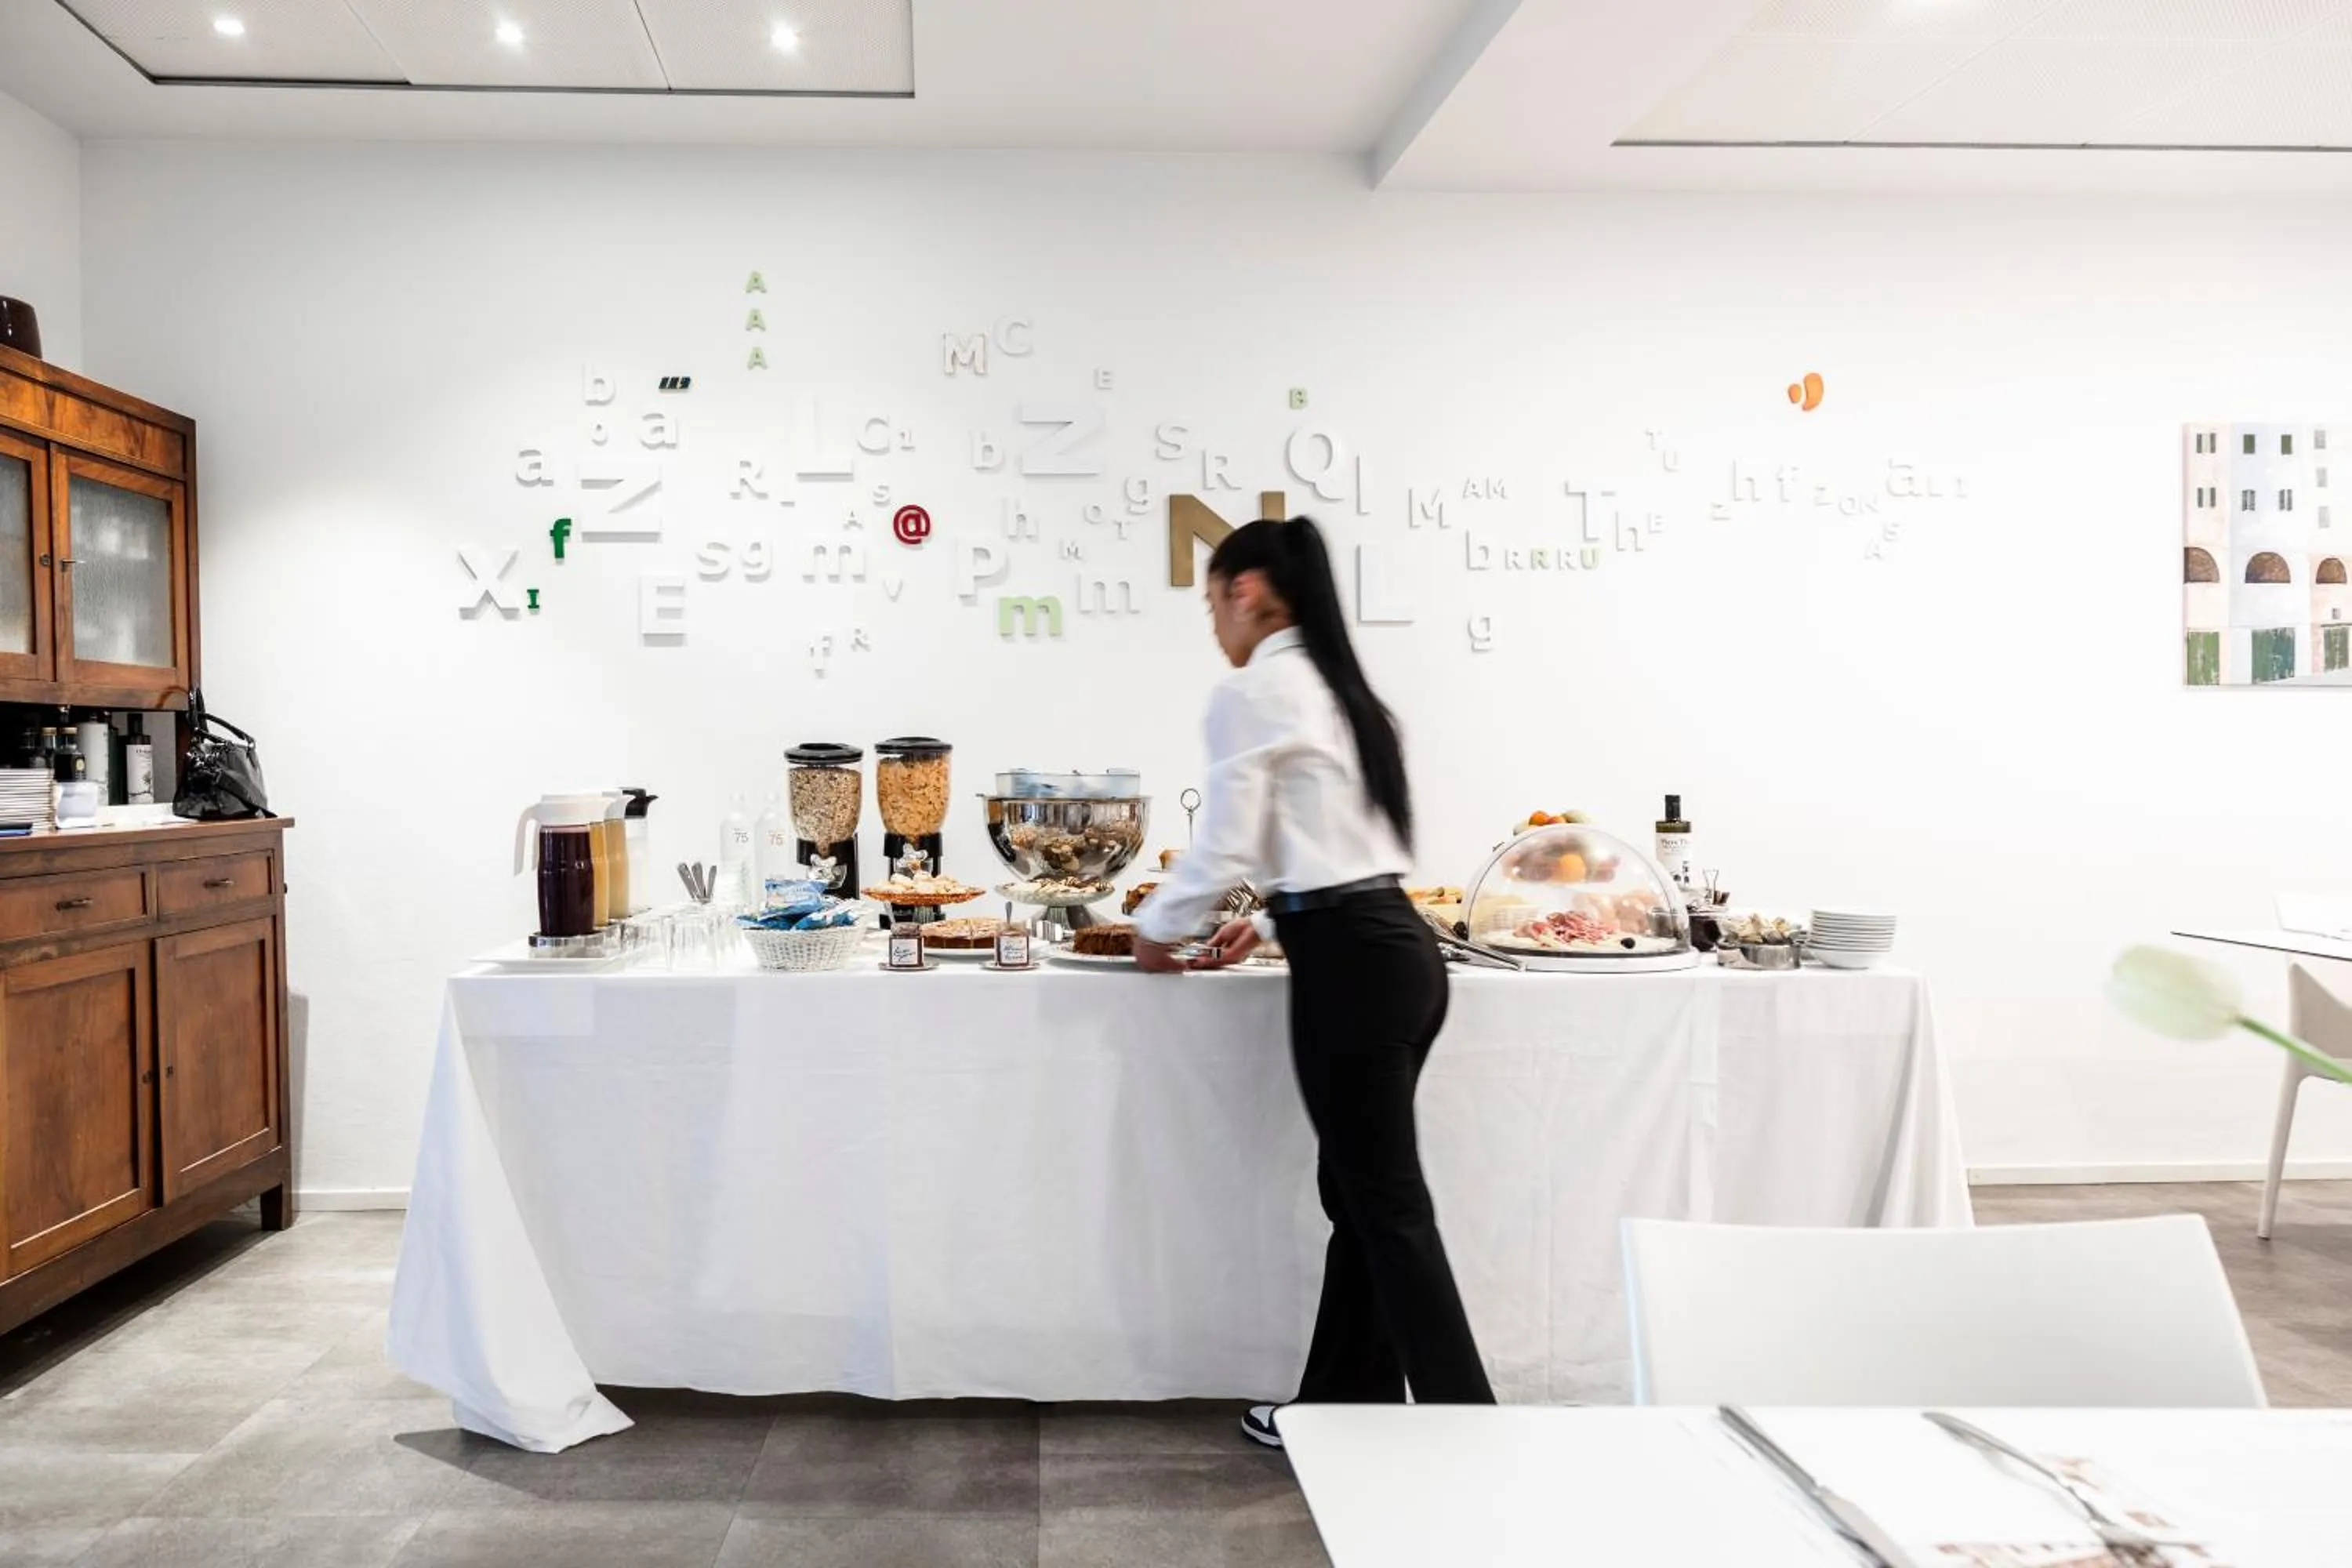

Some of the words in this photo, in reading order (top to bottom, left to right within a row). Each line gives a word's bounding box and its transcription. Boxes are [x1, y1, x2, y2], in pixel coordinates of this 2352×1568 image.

[746, 270, 768, 293] A
[745, 307, 767, 332] A
[993, 314, 1035, 357] C
[746, 346, 768, 371] A
[942, 329, 989, 376] M
[1093, 365, 1113, 391] E
[639, 408, 679, 450] a
[1015, 400, 1107, 480] Z
[516, 444, 555, 488] a
[729, 455, 770, 500] R
[1201, 448, 1242, 491] R
[1283, 427, 1347, 504] Q
[577, 459, 663, 543] Z
[550, 515, 574, 564] f
[892, 503, 933, 548] @
[457, 543, 522, 621] X
[955, 536, 1010, 606] P
[637, 574, 687, 647] E
[997, 596, 1064, 641] m
[734, 832, 749, 844] 75
[768, 833, 784, 845] 75
